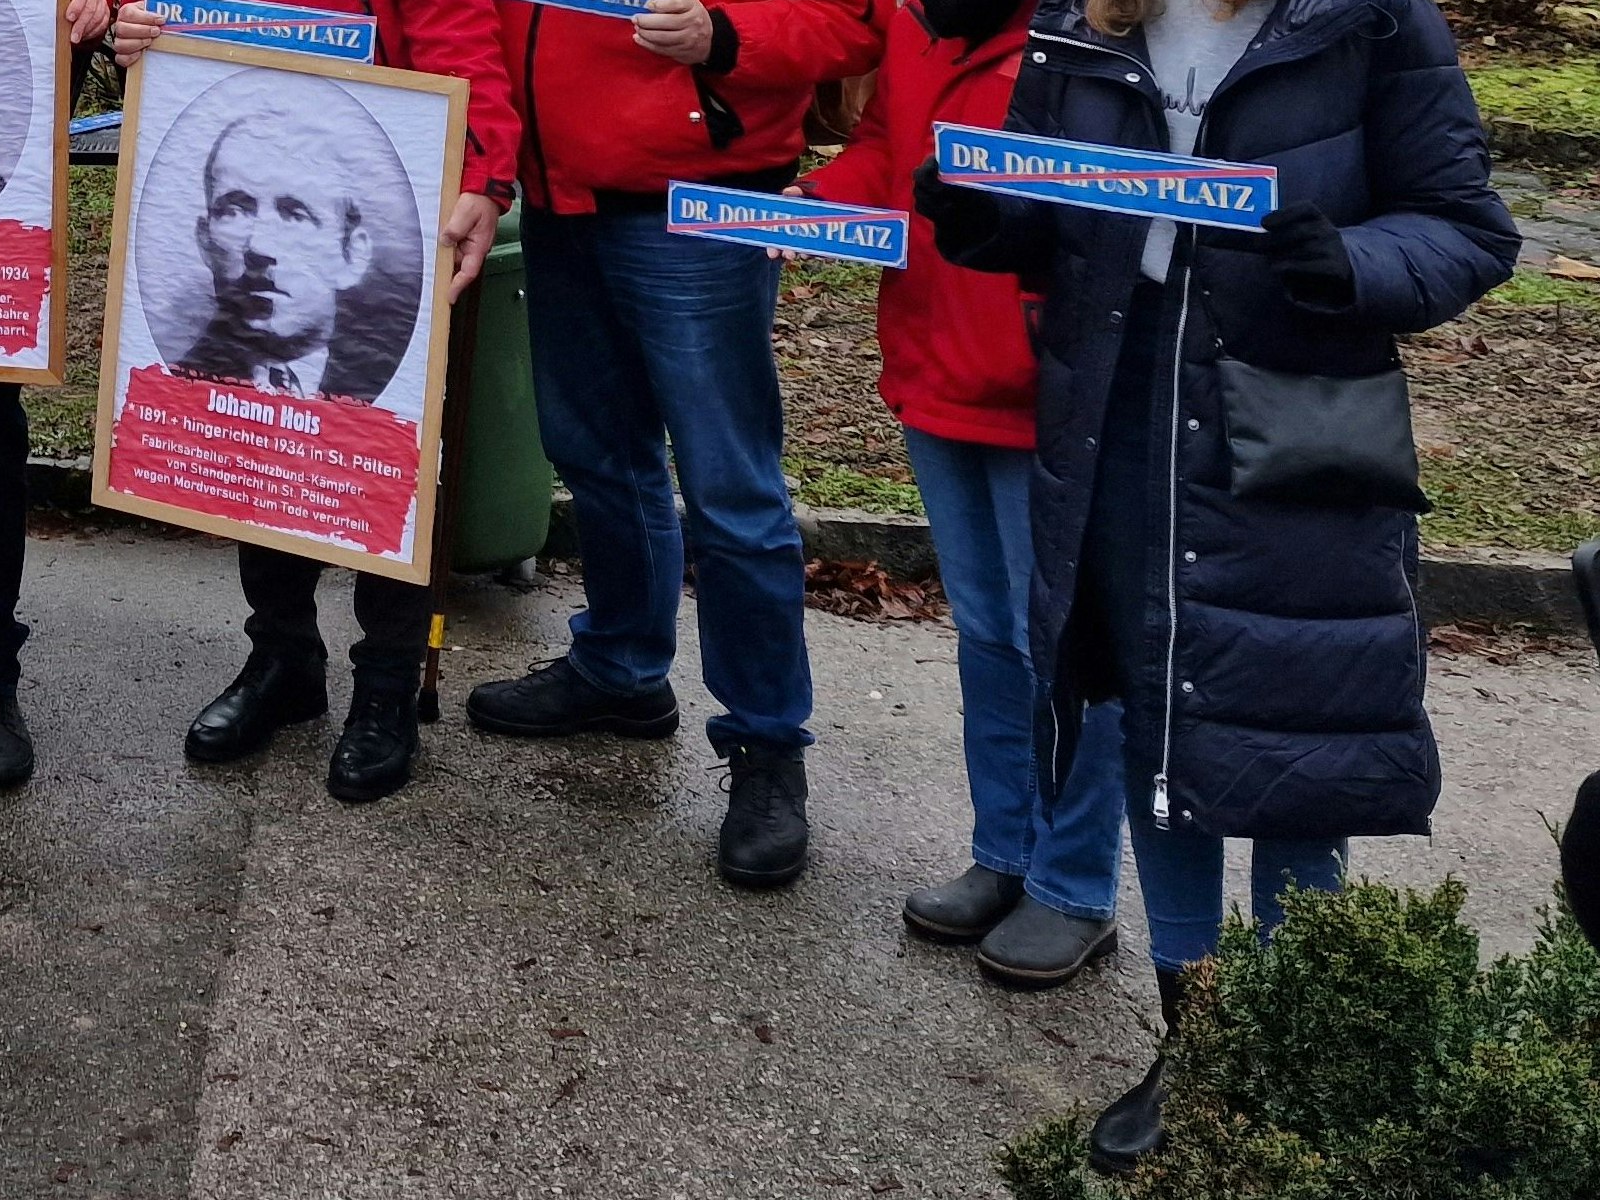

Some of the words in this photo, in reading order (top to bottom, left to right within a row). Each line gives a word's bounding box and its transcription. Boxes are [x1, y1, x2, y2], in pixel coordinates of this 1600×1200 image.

[156, 1, 186, 23] DR.
[194, 8, 290, 38] DOLLFUSS
[298, 24, 361, 48] PLATZ
[951, 143, 997, 173] DR.
[1005, 151, 1148, 197] DOLLFUSS
[1158, 178, 1255, 212] PLATZ
[681, 198, 713, 222] DR.
[719, 204, 820, 238] DOLLFUSS
[826, 221, 892, 250] PLATZ
[1, 267, 29, 280] 1934
[207, 389, 274, 425] Johann
[280, 406, 321, 435] Hois
[139, 406, 166, 424] 1891
[183, 416, 269, 449] hingerichtet
[274, 438, 305, 457] 1934
[311, 444, 322, 459] in
[328, 450, 347, 467] St.
[353, 456, 402, 479] Pölten
[141, 434, 232, 467] Fabriksarbeiter,
[236, 456, 366, 498] Schutzbund-Kämpfer,
[133, 467, 171, 486] wegen
[174, 476, 250, 504] Mordversuch
[253, 497, 277, 510] zum
[281, 501, 309, 518] Tode
[312, 510, 373, 533] verurteilt.
[166, 458, 186, 471] von
[190, 464, 264, 493] Standgericht
[268, 481, 277, 492] in
[281, 484, 298, 498] St.
[301, 488, 340, 508] Pölten
